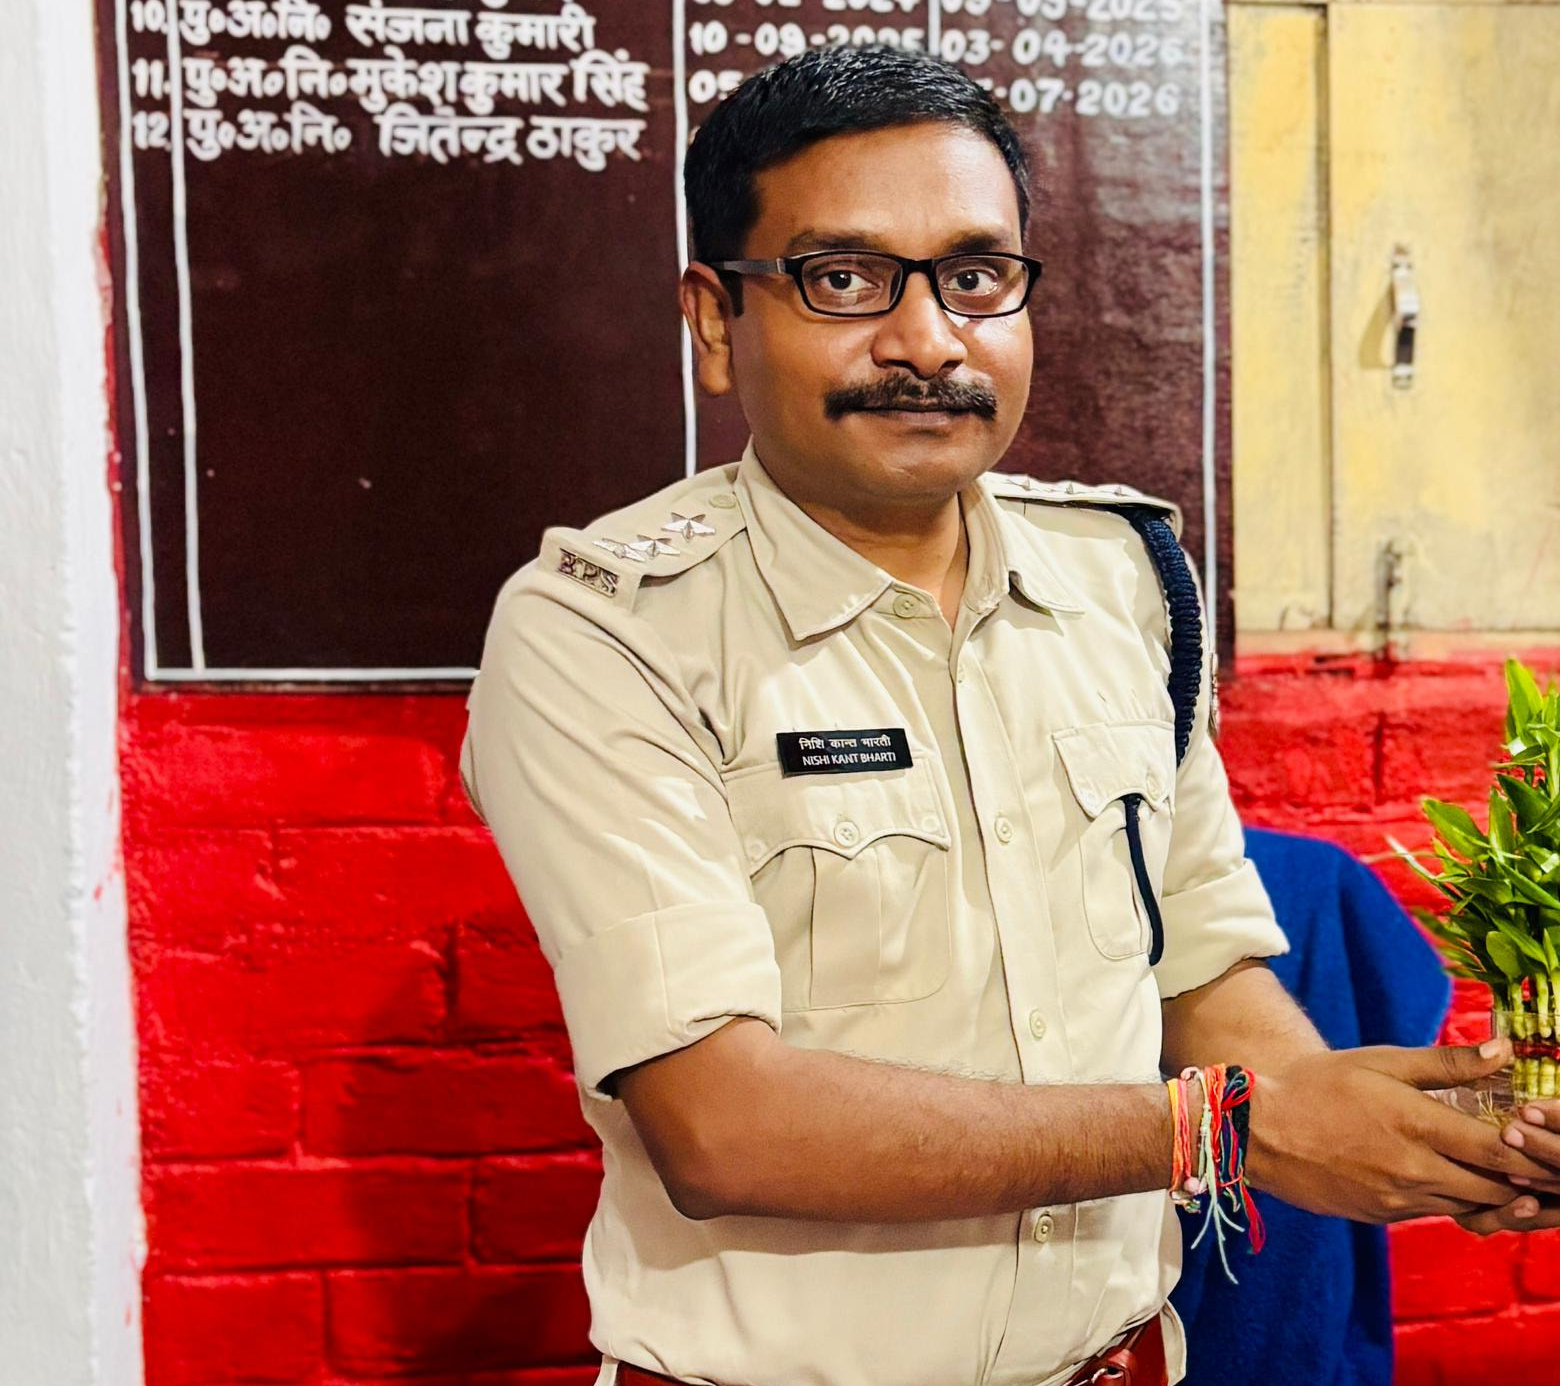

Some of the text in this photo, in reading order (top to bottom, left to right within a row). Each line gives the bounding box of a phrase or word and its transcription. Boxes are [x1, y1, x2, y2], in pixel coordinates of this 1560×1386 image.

[475, 3, 596, 60] कुमारी
[345, 45, 462, 113] मुकेश
[460, 62, 569, 115] कुमार
[570, 49, 651, 112] सिंह
[526, 114, 647, 171] ठाकुर
[802, 751, 896, 766] NISHI KANT BHARTI
[860, 734, 891, 748] भारती
